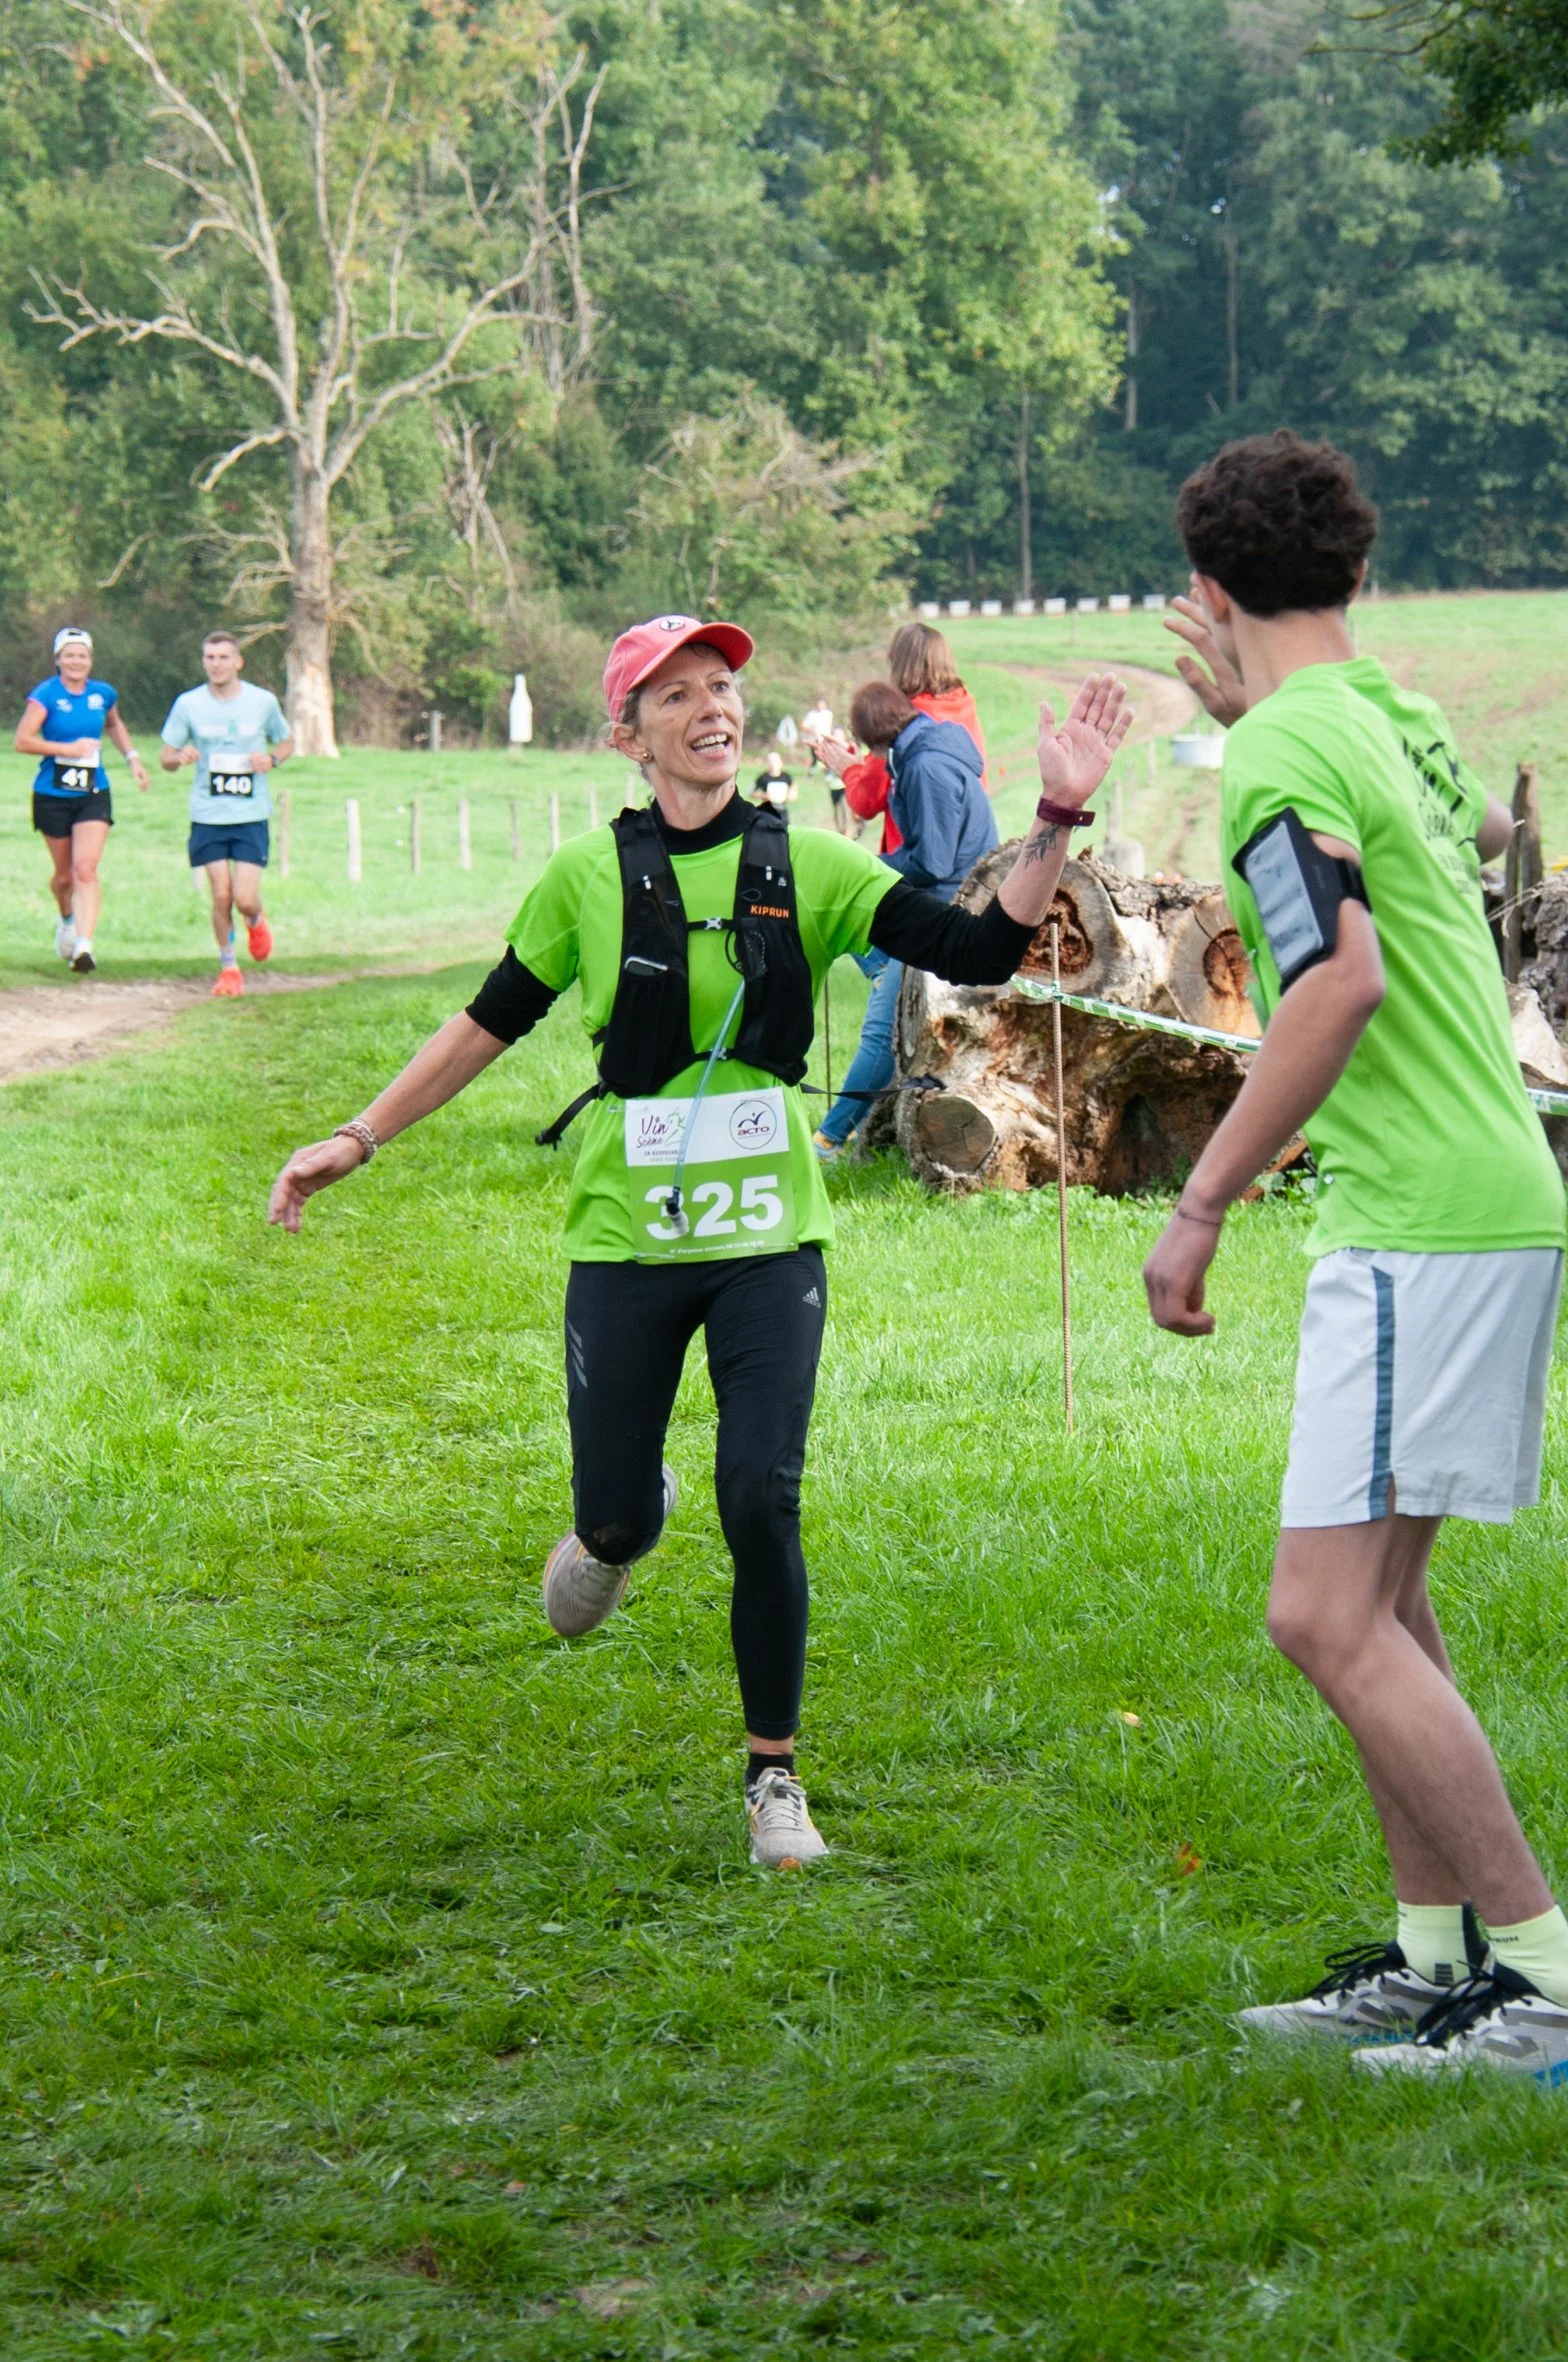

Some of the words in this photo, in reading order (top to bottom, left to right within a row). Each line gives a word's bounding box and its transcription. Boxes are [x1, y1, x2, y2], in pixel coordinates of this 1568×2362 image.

[61, 767, 89, 788] 41
[212, 775, 252, 794] 140
[750, 904, 790, 920] KIPRUN
[644, 1174, 784, 1240] 325
